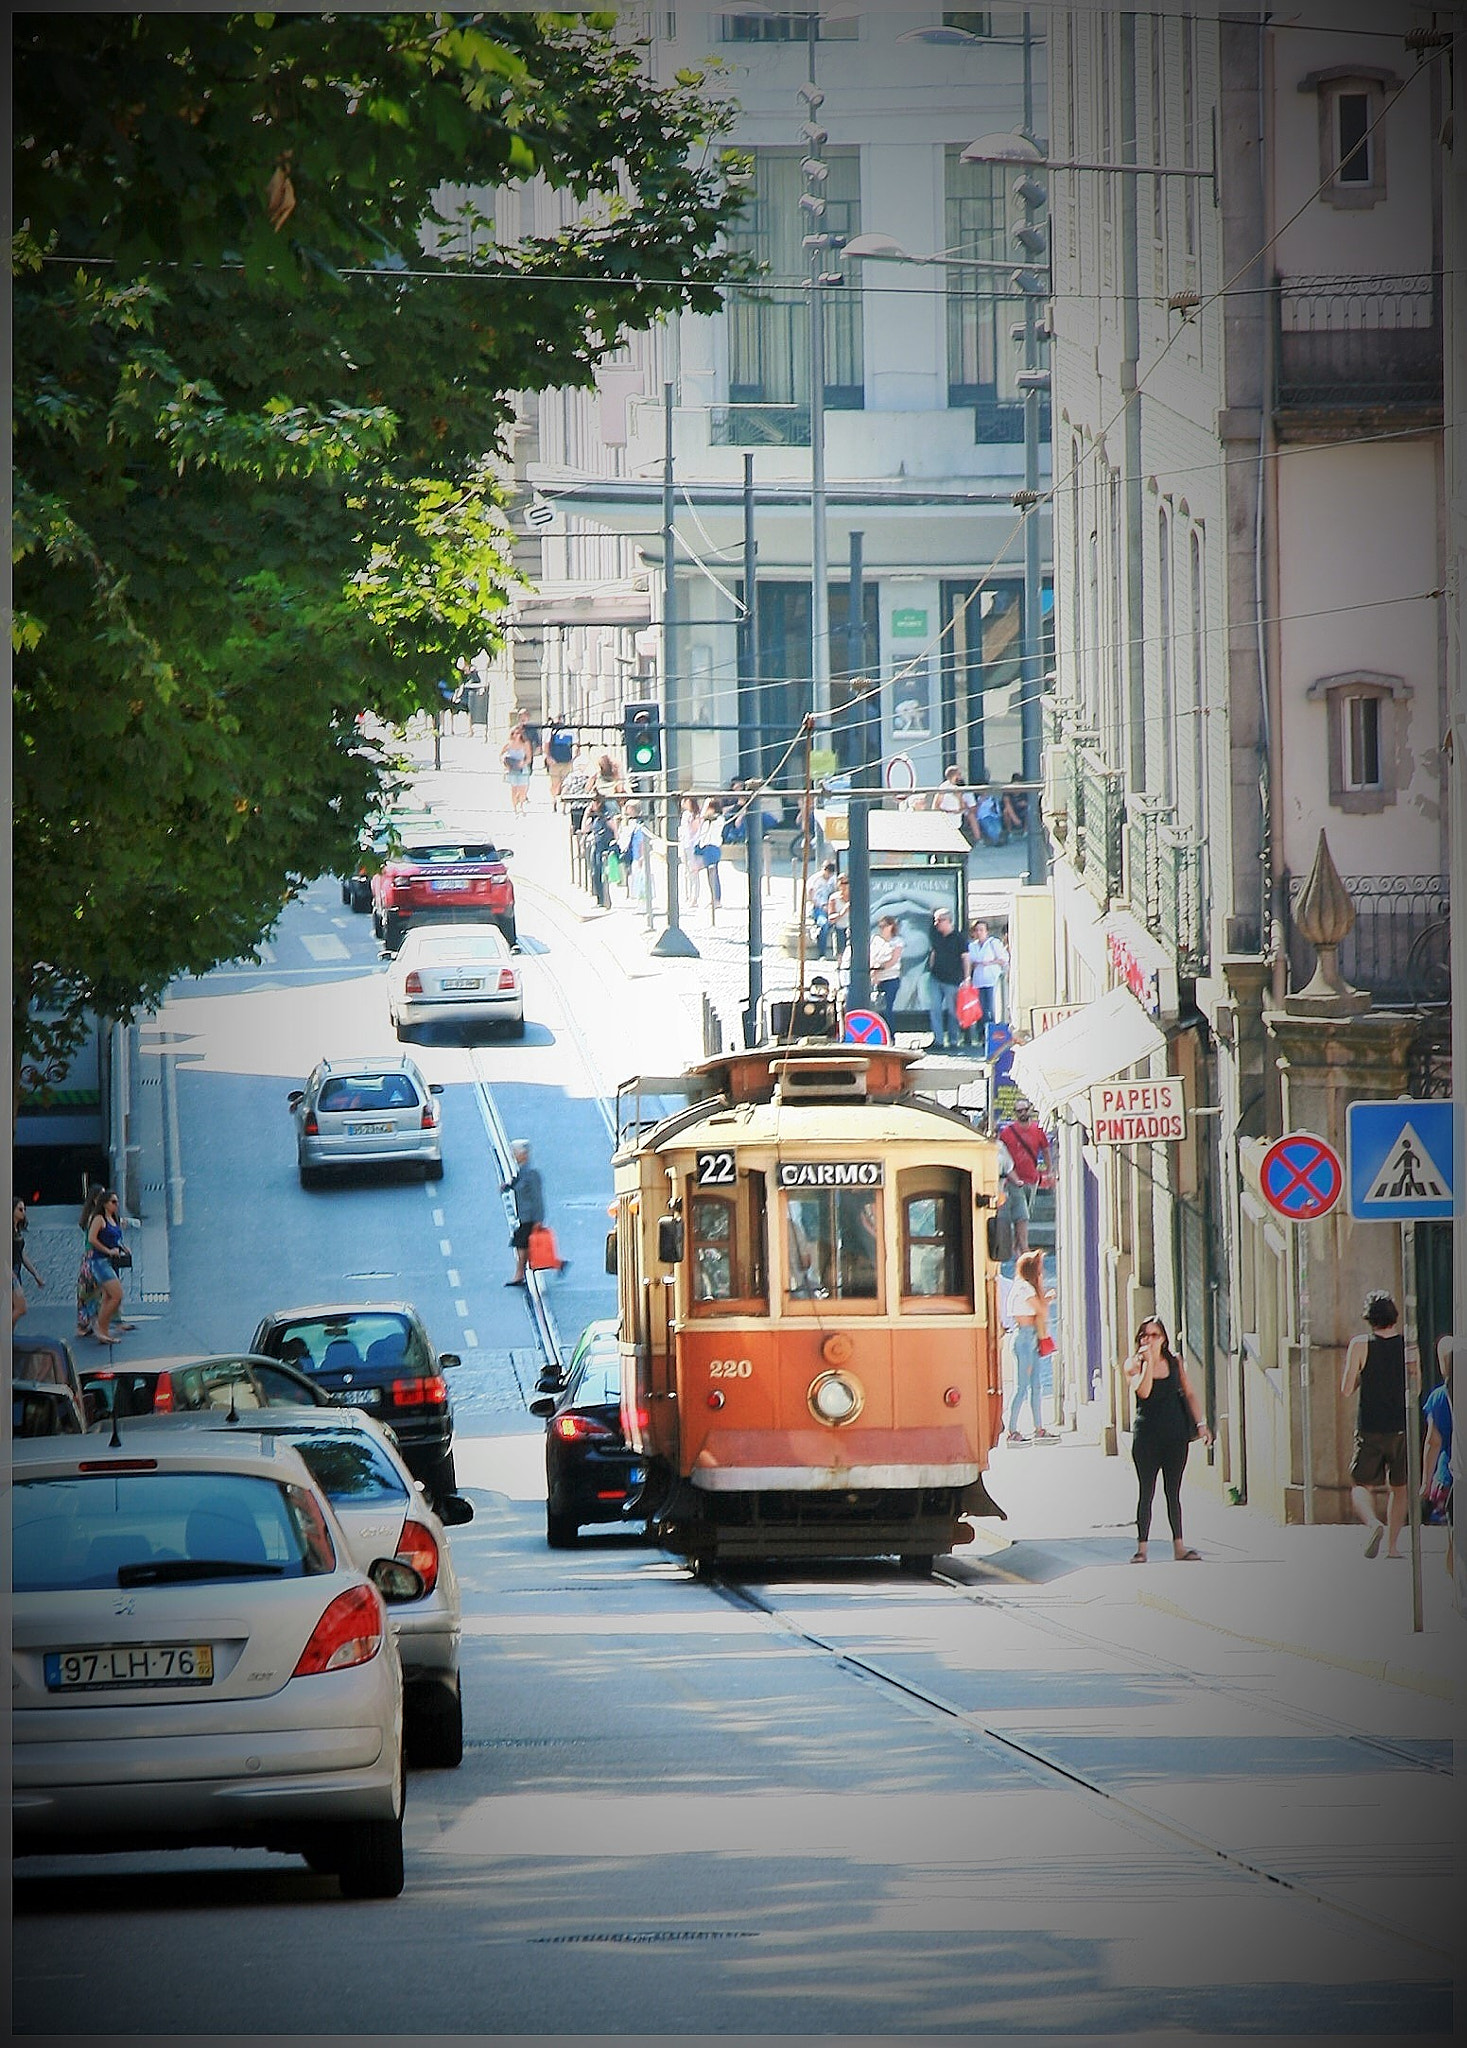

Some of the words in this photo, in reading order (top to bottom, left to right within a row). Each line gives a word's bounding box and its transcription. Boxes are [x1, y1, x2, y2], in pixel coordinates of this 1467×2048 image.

[1103, 1087, 1172, 1113] PAPEIS
[1095, 1115, 1182, 1142] PINTADOS
[699, 1153, 735, 1184] 22
[781, 1164, 878, 1185] CARMO
[709, 1360, 752, 1378] 220
